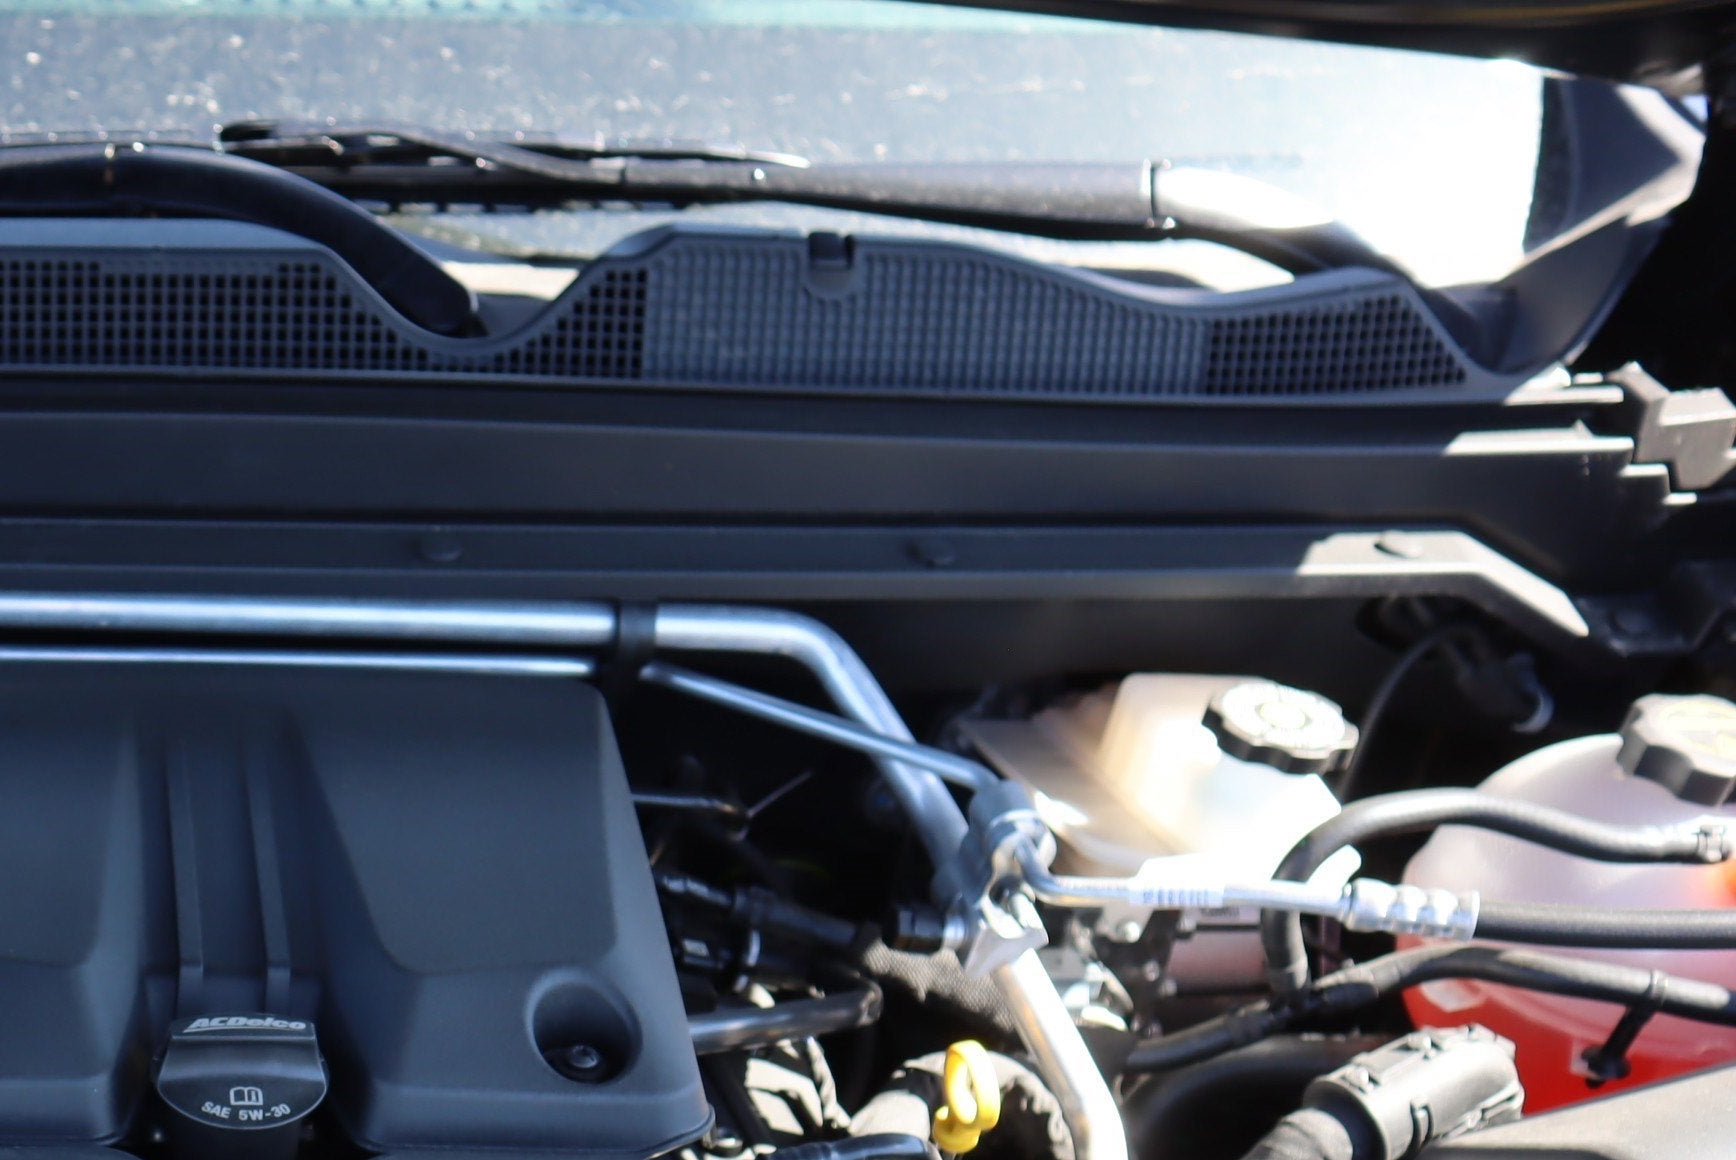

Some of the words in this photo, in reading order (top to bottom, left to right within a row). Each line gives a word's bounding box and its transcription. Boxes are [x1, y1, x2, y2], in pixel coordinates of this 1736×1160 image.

[183, 1016, 307, 1033] ACDelco
[201, 1101, 232, 1119] SAE
[239, 1104, 291, 1121] 5W-30
